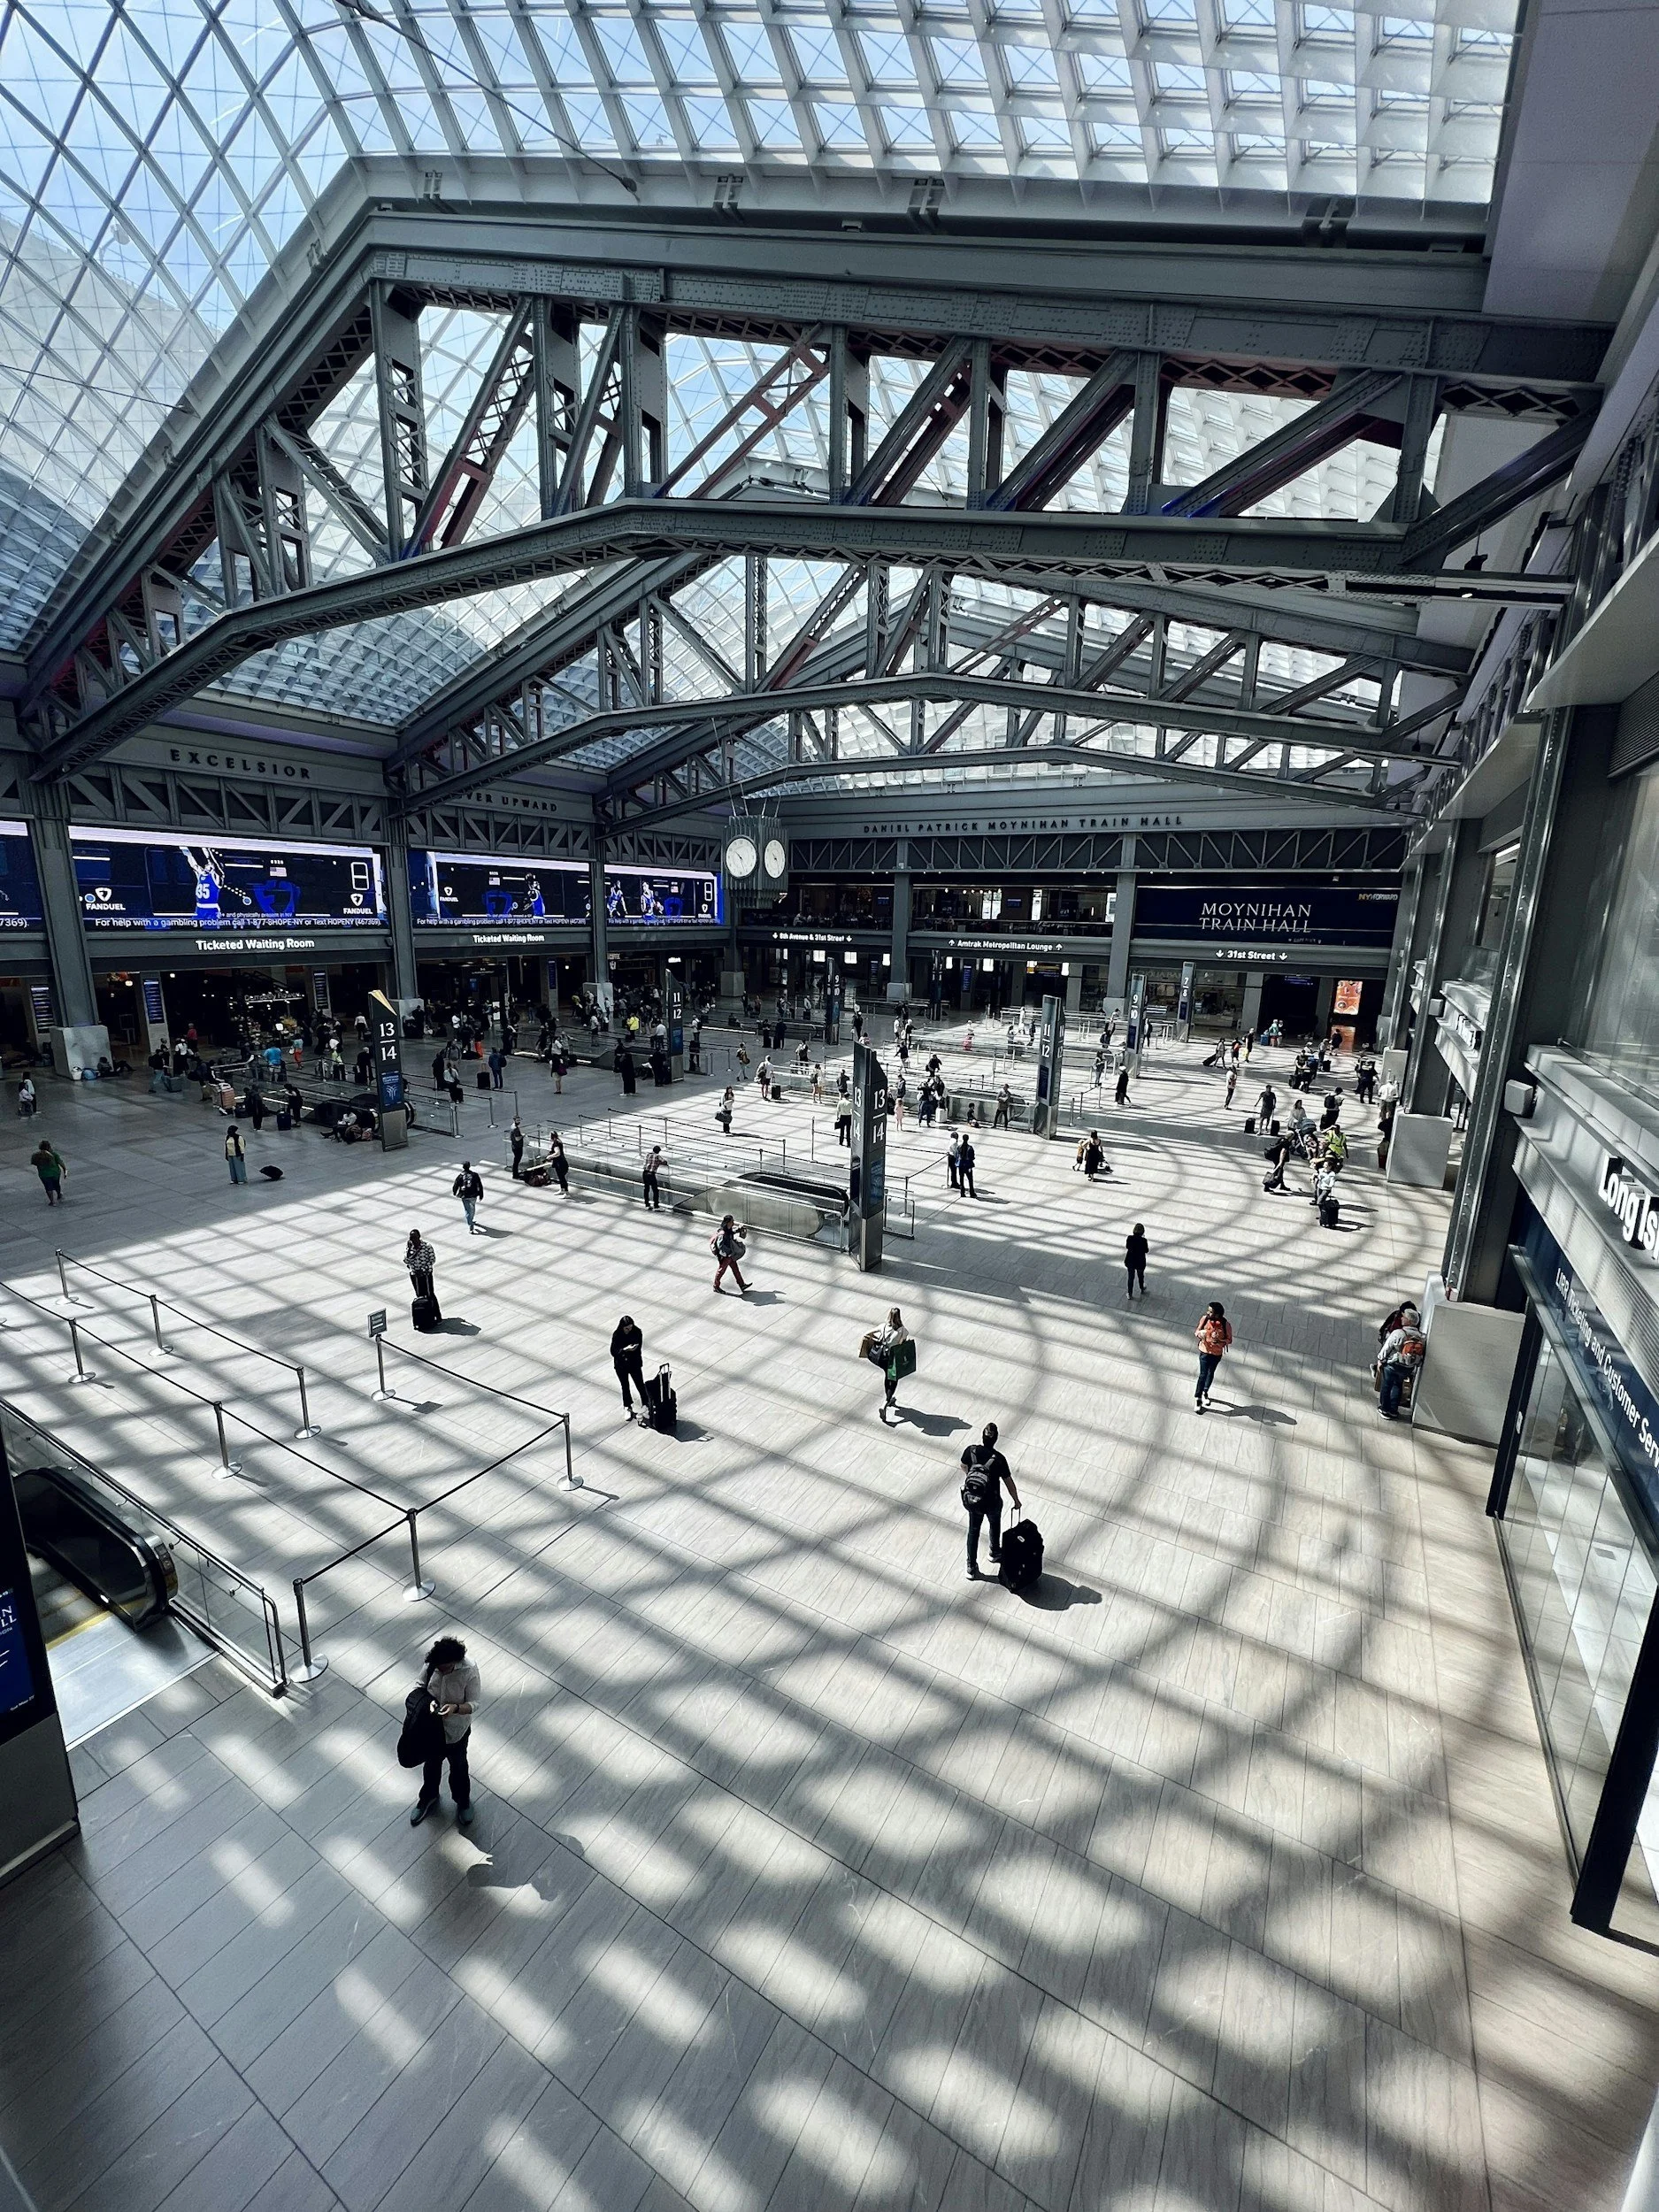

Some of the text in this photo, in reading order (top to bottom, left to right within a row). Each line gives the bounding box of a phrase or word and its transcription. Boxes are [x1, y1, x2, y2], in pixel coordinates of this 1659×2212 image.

[170, 749, 310, 779] EXCELSIOR
[502, 796, 557, 812] UPWARD
[918, 823, 978, 832] PATRICK
[988, 819, 1068, 830] MOYNIHAN
[1079, 818, 1128, 827] TRAIN
[1141, 816, 1181, 826] HALL
[1202, 902, 1311, 917] MOYNIHAN
[111, 918, 131, 927] help
[132, 918, 151, 926] with
[161, 918, 197, 927] gambling
[199, 918, 231, 927] problem
[232, 918, 245, 926] call
[328, 918, 354, 926] HOPENY
[1199, 918, 1311, 933] TRAIN HALL
[196, 938, 315, 950] Ticketed Waiting Room
[472, 933, 545, 944] Ticketed Waiting Room
[983, 941, 1025, 950] Metropolitan
[1026, 942, 1053, 952] Lounge
[1227, 949, 1275, 960] 31st Street
[1133, 994, 1139, 1004] 9
[672, 1009, 682, 1019] 12
[1130, 1009, 1138, 1019] 10
[379, 1022, 395, 1037] 13
[1044, 1023, 1051, 1037] 11
[380, 1046, 397, 1061] 14
[1041, 1044, 1050, 1058] 12
[854, 1086, 862, 1108] 13
[873, 1088, 886, 1110] 13
[853, 1119, 860, 1141] 14
[872, 1122, 885, 1144] 14
[1598, 1154, 1640, 1241] Long
[1555, 1267, 1570, 1301] LIRR
[1568, 1287, 1594, 1348] Ticketing
[1591, 1336, 1606, 1366] and
[1603, 1354, 1641, 1429] Customer
